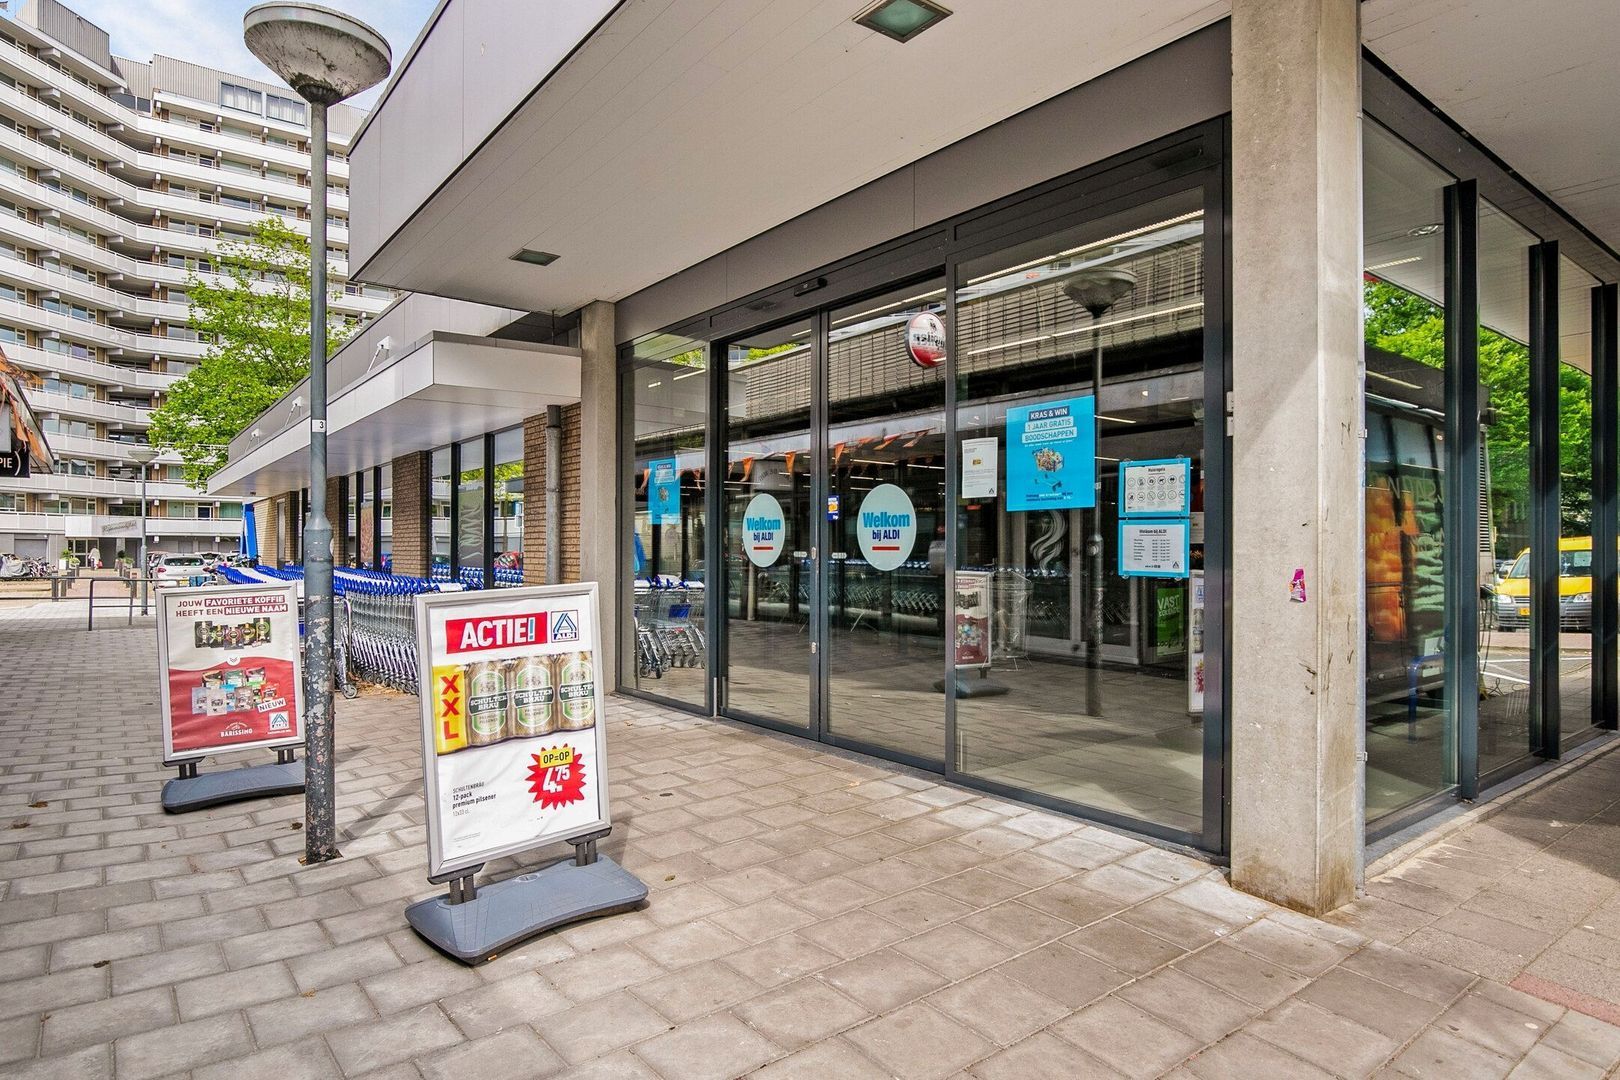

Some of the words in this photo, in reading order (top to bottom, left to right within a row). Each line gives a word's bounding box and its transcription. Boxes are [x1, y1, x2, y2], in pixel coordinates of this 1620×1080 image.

[1030, 410, 1048, 420] KRAS
[1054, 407, 1068, 416] WIN
[319, 420, 324, 428] 3
[1032, 422, 1048, 430] JAAR
[1049, 418, 1072, 428] GRATIS
[1024, 429, 1074, 442] BOODSCHAPPEN
[746, 517, 780, 532] Welkom
[862, 511, 910, 528] Welkom
[760, 531, 774, 540] ALDI
[872, 529, 882, 542] bij
[882, 529, 900, 540] ALDI
[177, 599, 202, 608] JOUW
[205, 598, 252, 606] FAVORIETE
[254, 595, 284, 604] KOFFIE
[1157, 594, 1180, 610] VAST
[225, 606, 260, 614] NIEUWE
[261, 604, 288, 612] NAAM
[460, 617, 536, 650] ACTIE!
[554, 631, 576, 640] ALDI
[259, 699, 284, 710] NIEUW
[220, 728, 252, 738] BARISSIMO
[543, 751, 570, 764] OP=OP
[452, 797, 476, 810] premium
[475, 793, 496, 804] pilsener
[453, 791, 472, 800] 12-pack
